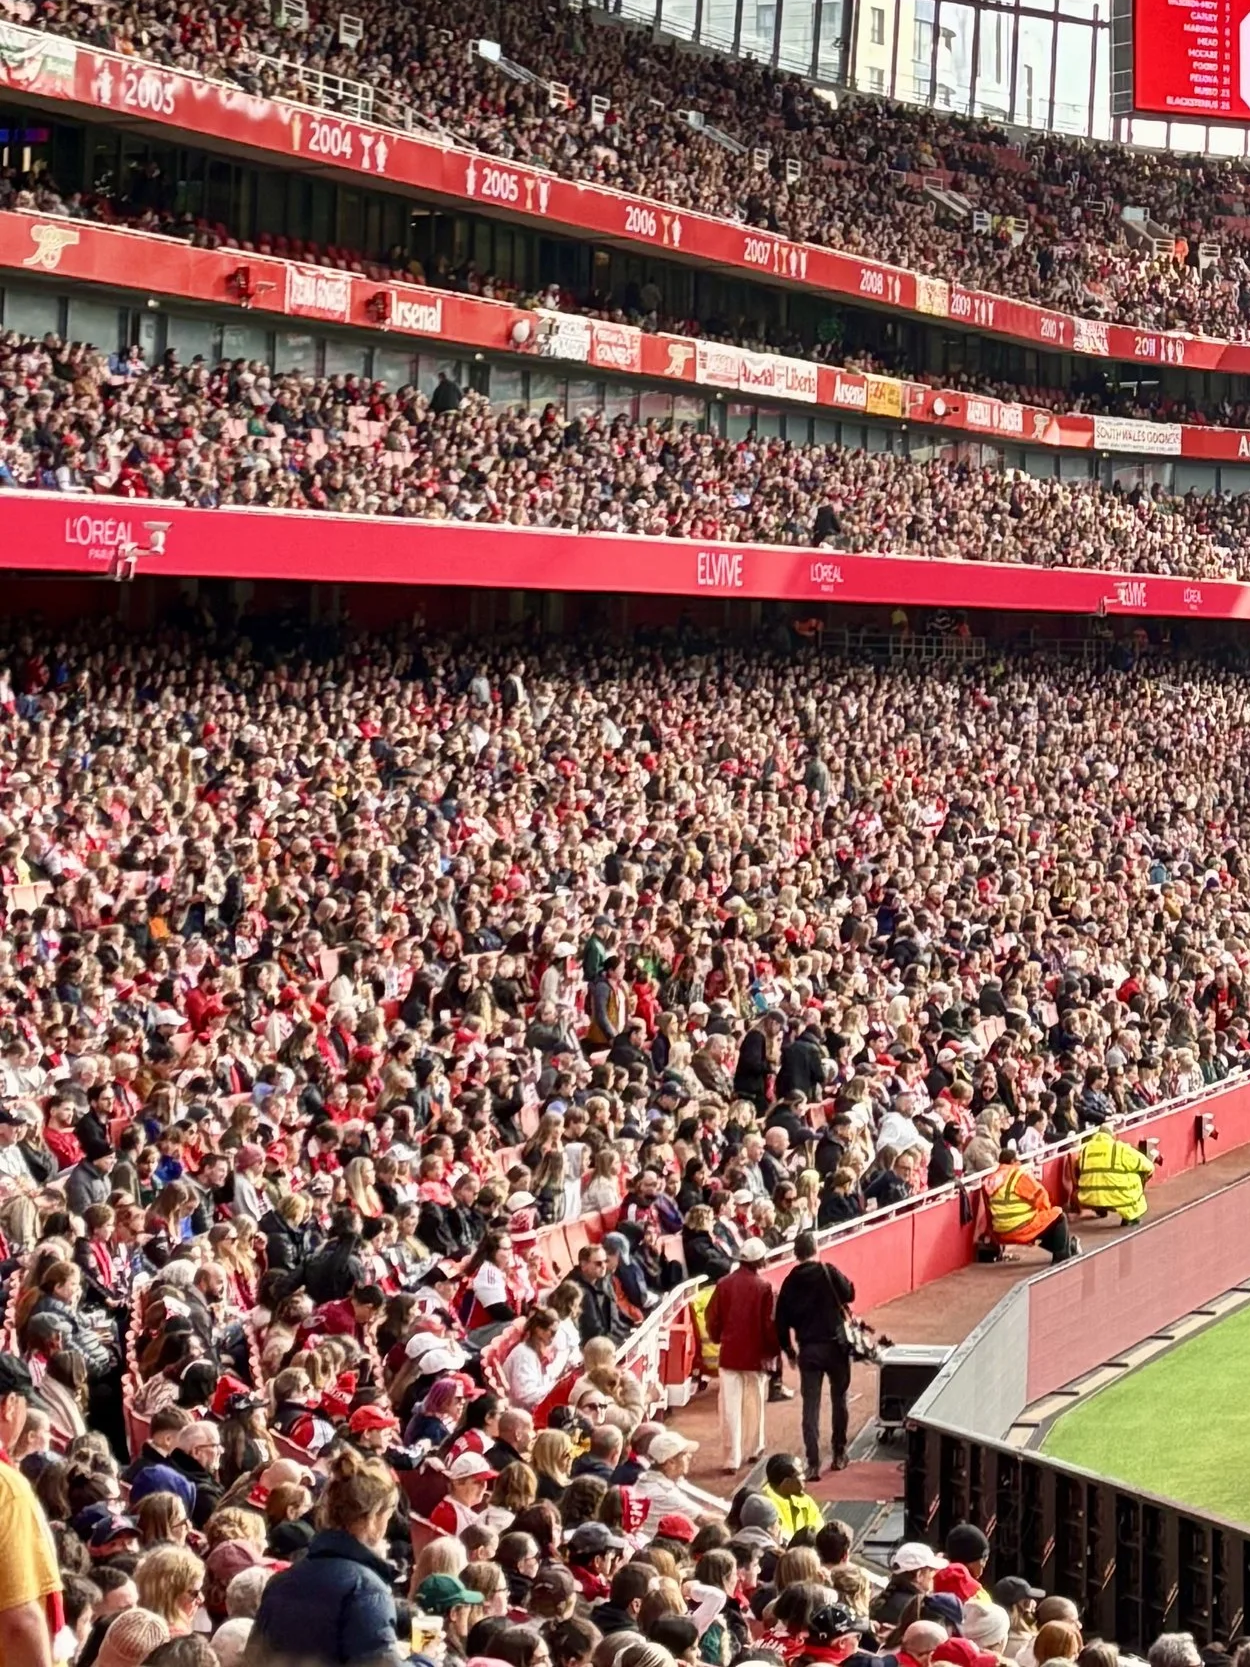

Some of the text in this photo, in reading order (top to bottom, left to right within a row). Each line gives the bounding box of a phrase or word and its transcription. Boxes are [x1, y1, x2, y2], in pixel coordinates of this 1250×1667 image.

[309, 122, 352, 159] 2004
[481, 168, 518, 201] 2005
[625, 206, 656, 236] 2006
[744, 237, 771, 265] 2007
[833, 374, 868, 407] Arsenal
[697, 552, 743, 587] ELVIVE
